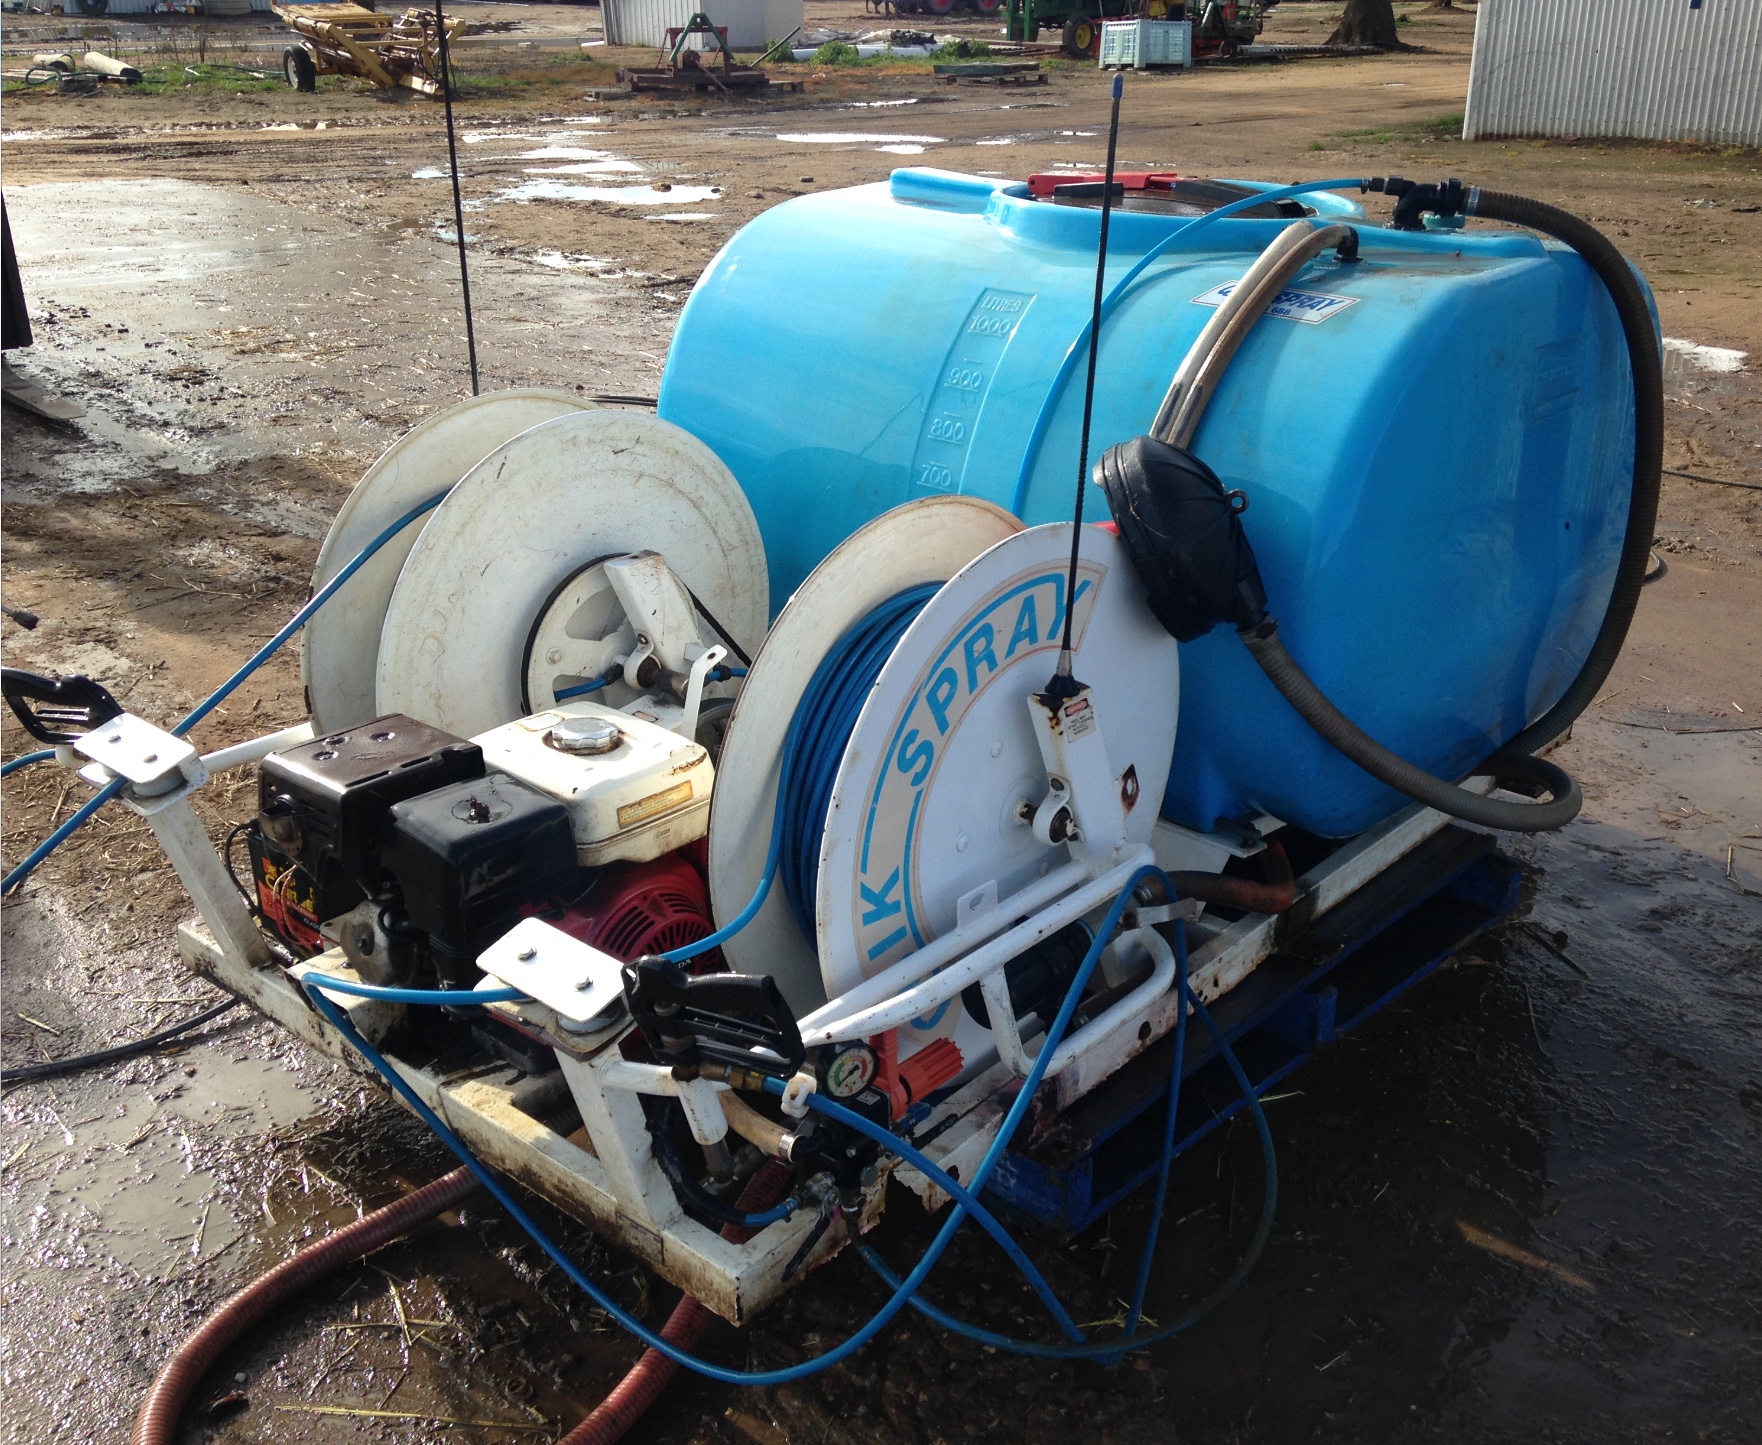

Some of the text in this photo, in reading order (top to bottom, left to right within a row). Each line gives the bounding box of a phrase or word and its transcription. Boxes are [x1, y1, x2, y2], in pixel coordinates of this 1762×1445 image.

[981, 295, 1023, 313] LITRES
[969, 315, 1012, 335] 1000
[948, 367, 983, 388] 900
[930, 418, 965, 441] 800
[921, 463, 952, 487] 700
[897, 572, 1093, 788] SPRAY
